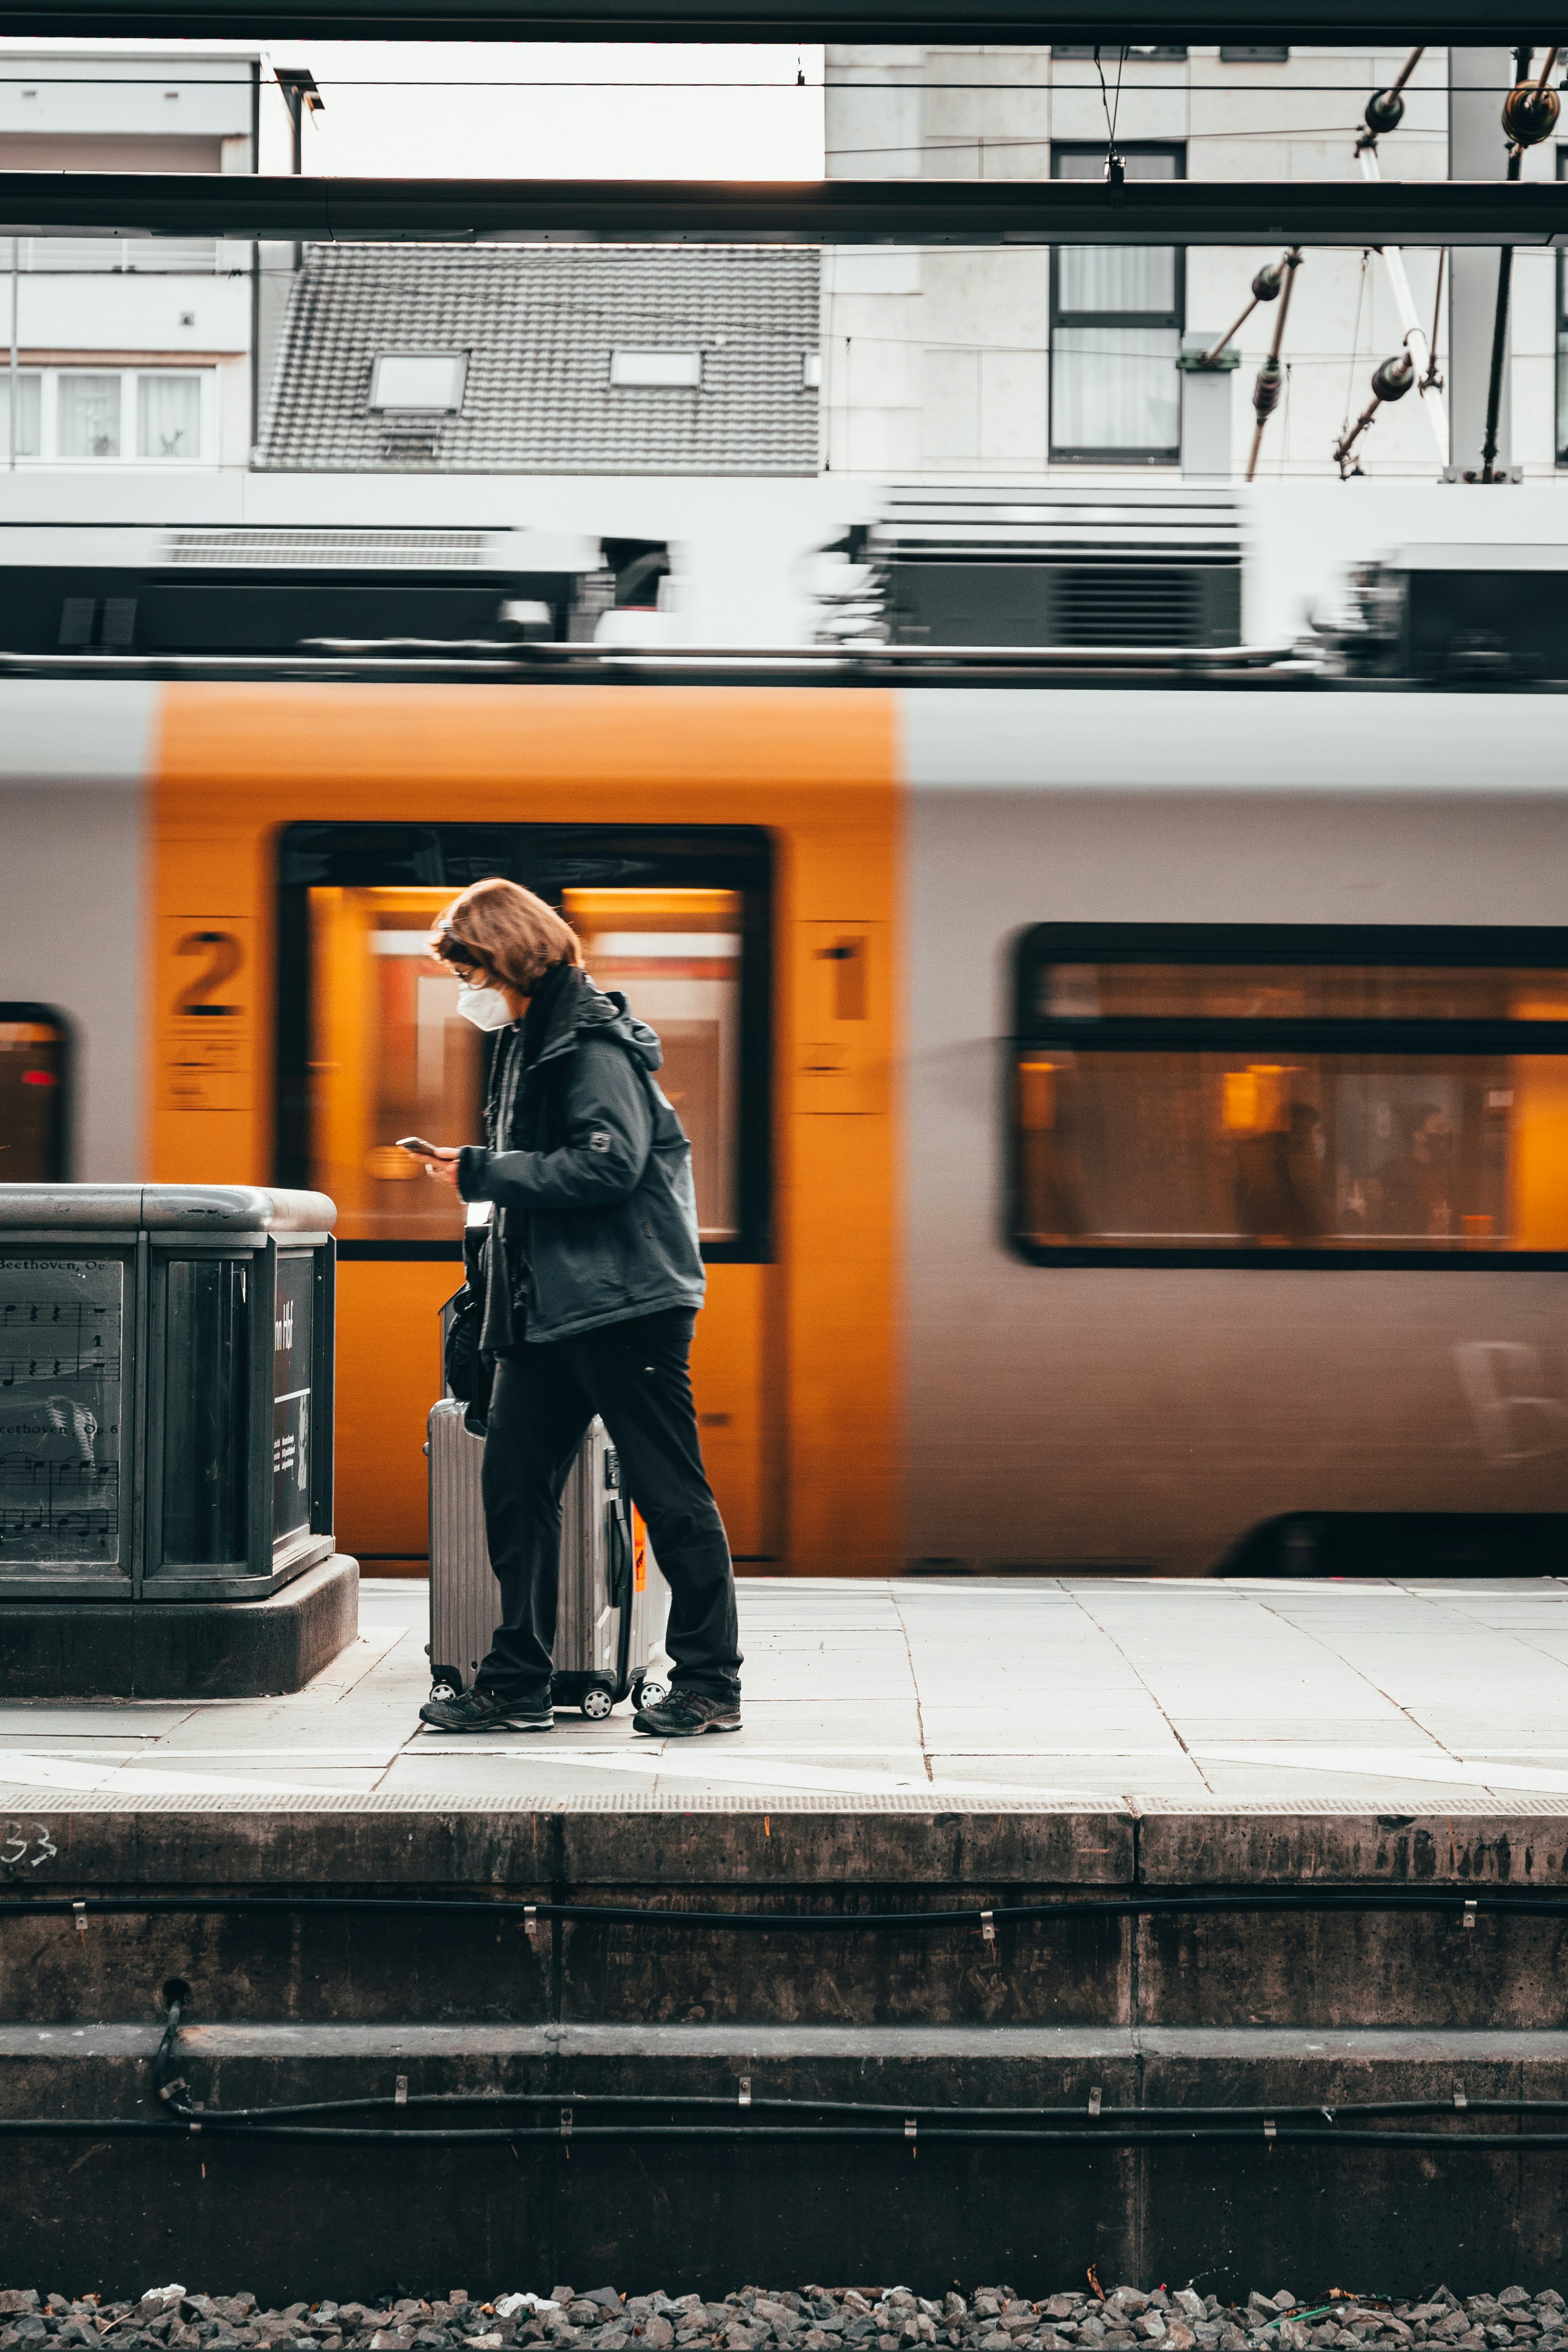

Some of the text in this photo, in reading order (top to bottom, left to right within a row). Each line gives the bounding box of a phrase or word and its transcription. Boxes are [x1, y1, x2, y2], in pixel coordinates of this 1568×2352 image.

[171, 931, 247, 1016] 2
[812, 935, 870, 1020] 1
[93, 1335, 104, 1347] 1
[283, 1300, 293, 1350] Hbf
[1, 1821, 58, 1867] 33
